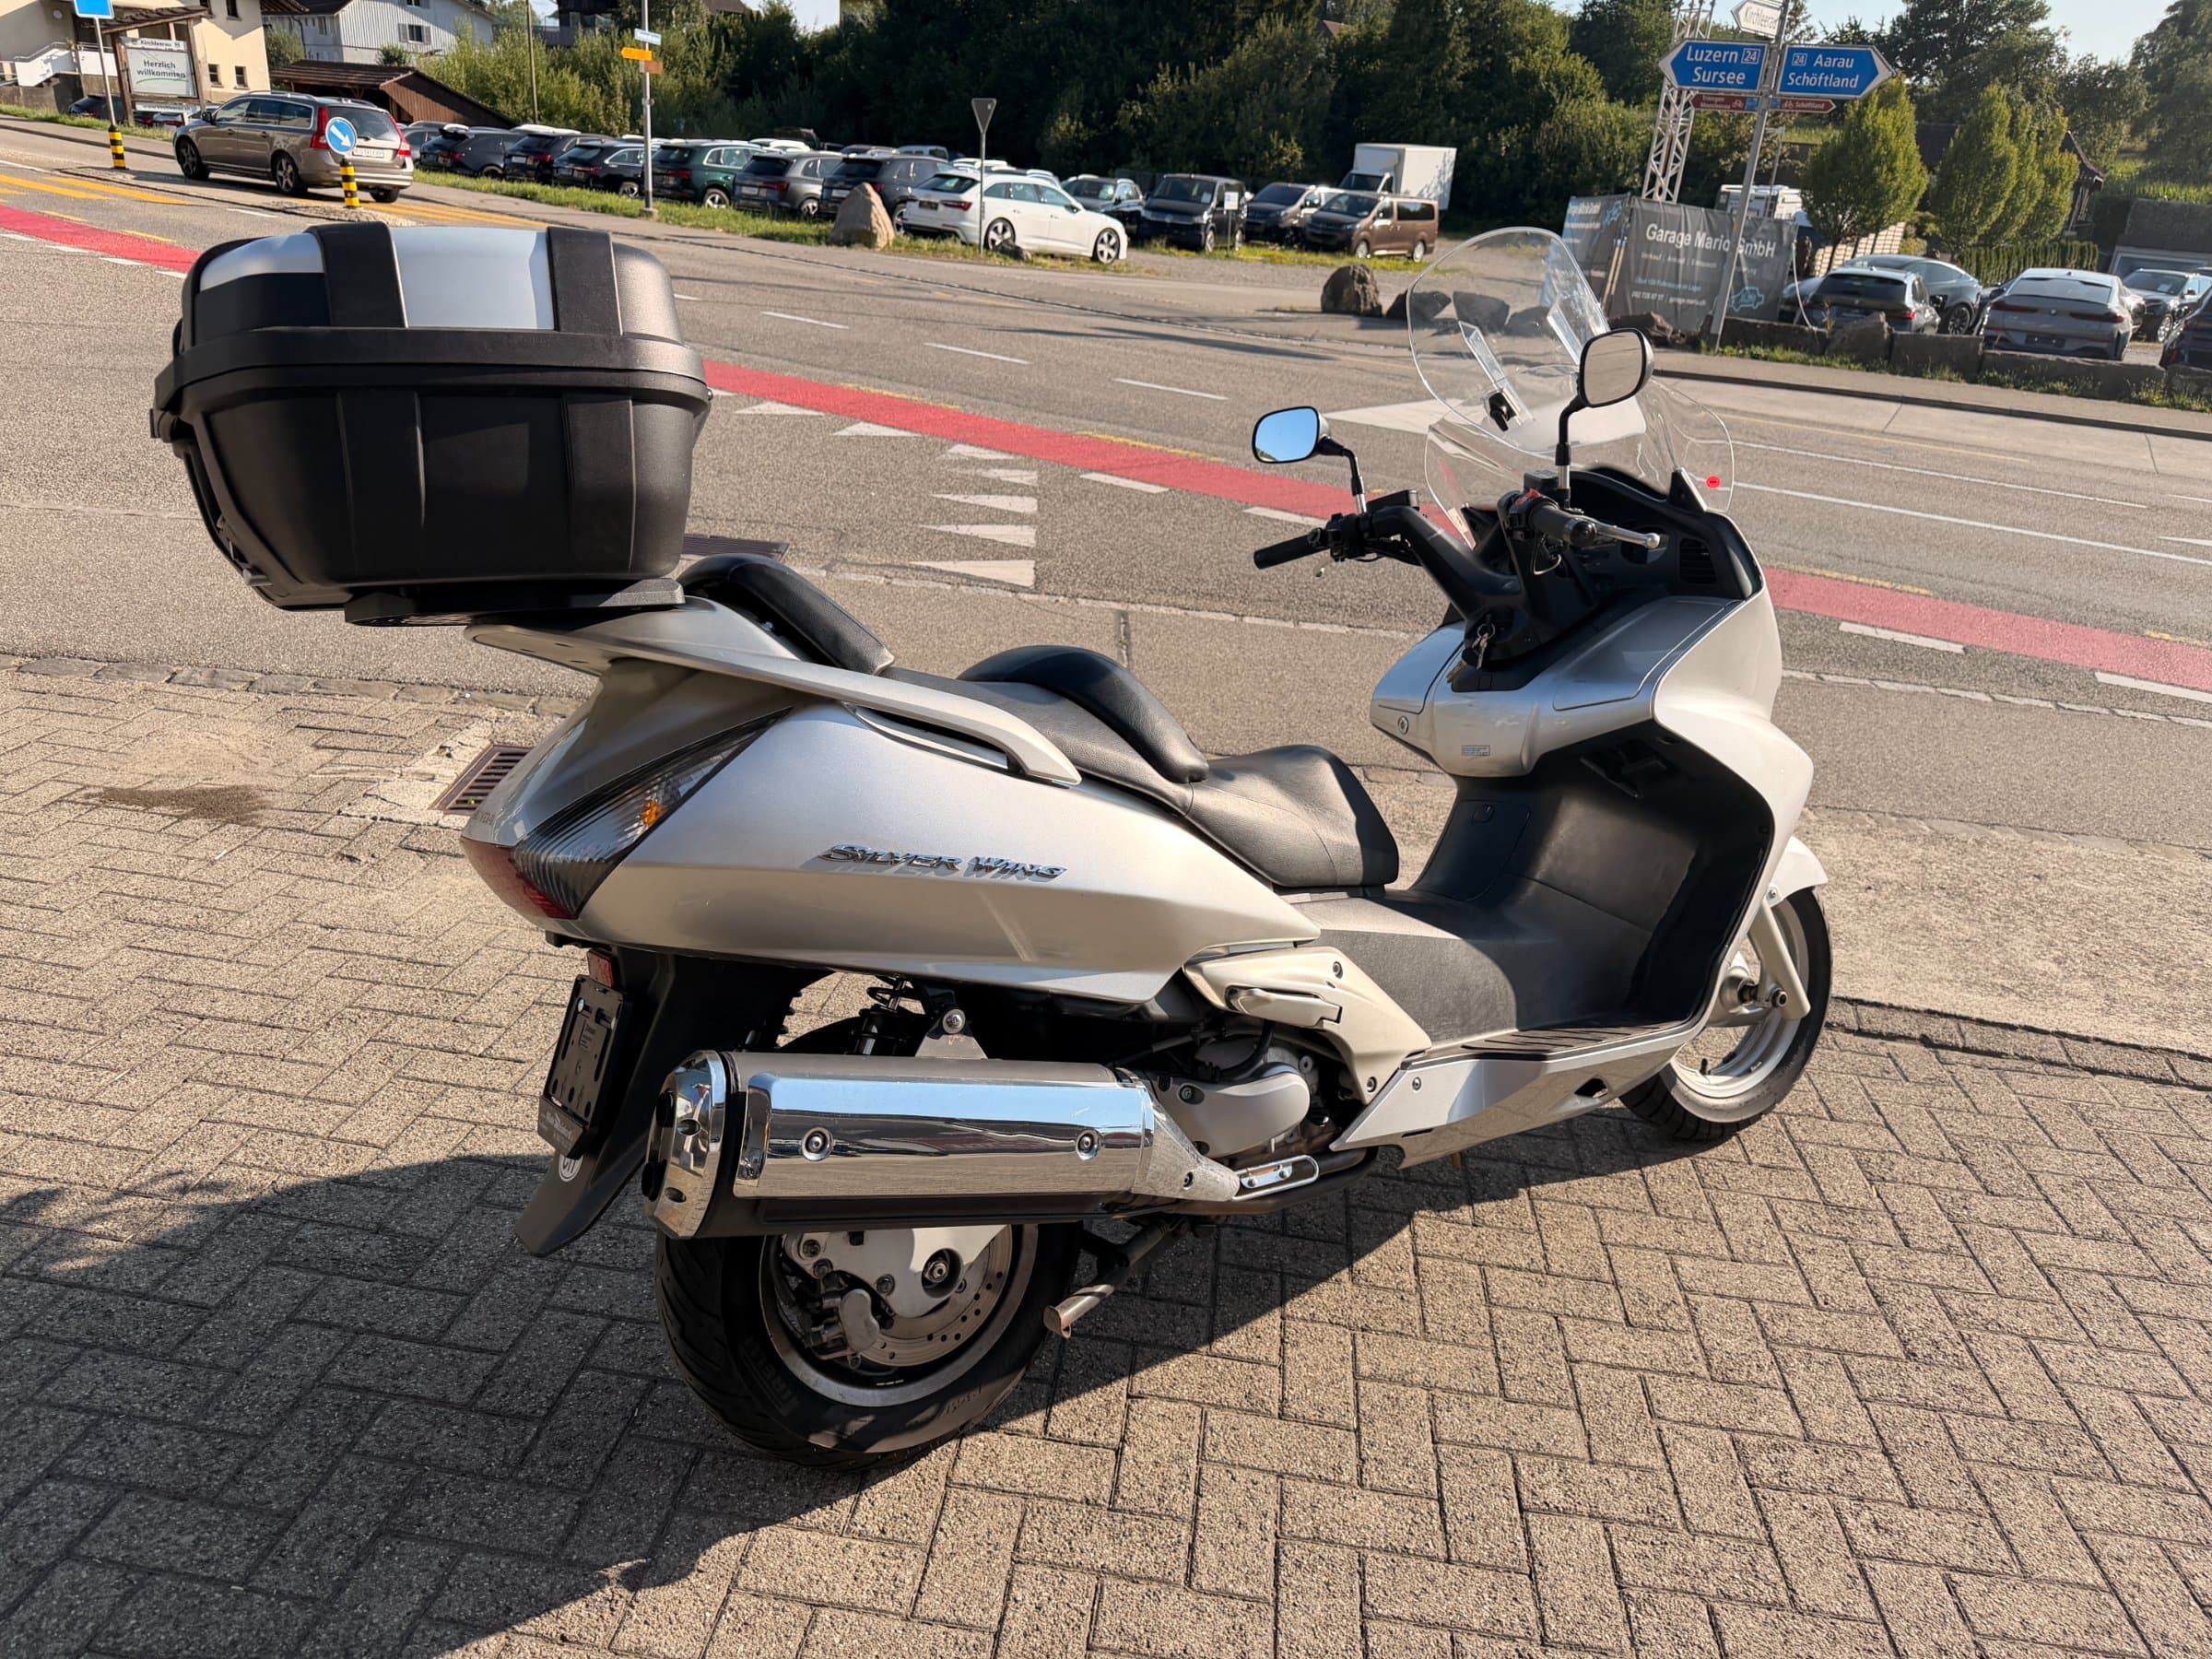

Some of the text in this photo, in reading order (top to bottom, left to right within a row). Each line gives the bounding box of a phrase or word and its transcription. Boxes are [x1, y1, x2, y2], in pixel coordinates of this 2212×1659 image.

[1686, 44, 1759, 64] Luzern 24
[1792, 53, 1854, 68] 24 Aarau
[136, 68, 186, 78] willkommen
[144, 60, 176, 69] Herzlich
[1692, 66, 1746, 85] Sursee
[1787, 72, 1859, 88] Schöftland
[1646, 223, 1777, 259] Garage Mario GmbH
[818, 843, 1067, 879] SILVER WING
